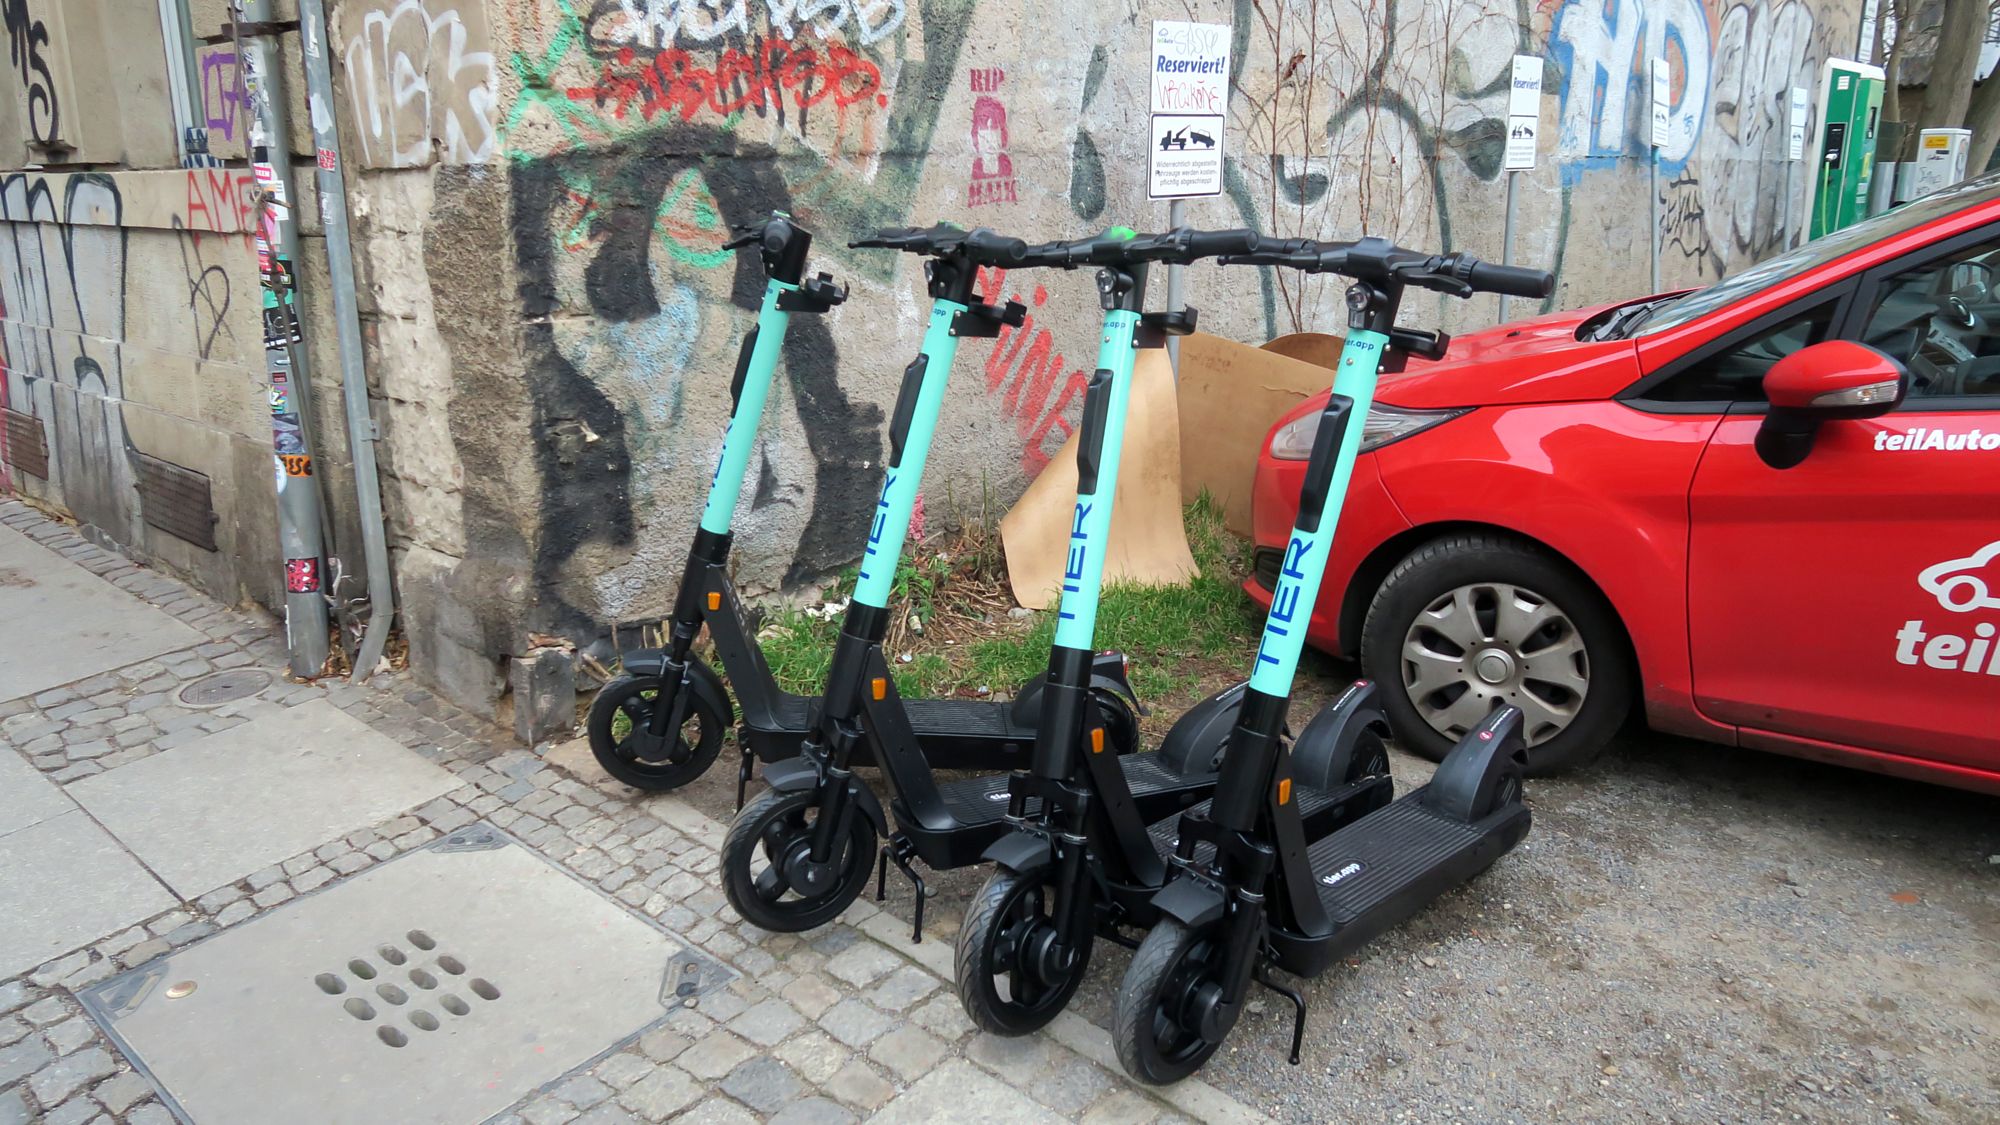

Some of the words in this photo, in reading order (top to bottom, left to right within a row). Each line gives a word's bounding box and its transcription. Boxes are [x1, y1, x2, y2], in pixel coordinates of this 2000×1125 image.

[1156, 54, 1226, 75] Reserviert!
[969, 67, 1005, 92] RIP
[1253, 537, 1314, 676] TIER
[1322, 862, 1361, 885] tier.app
